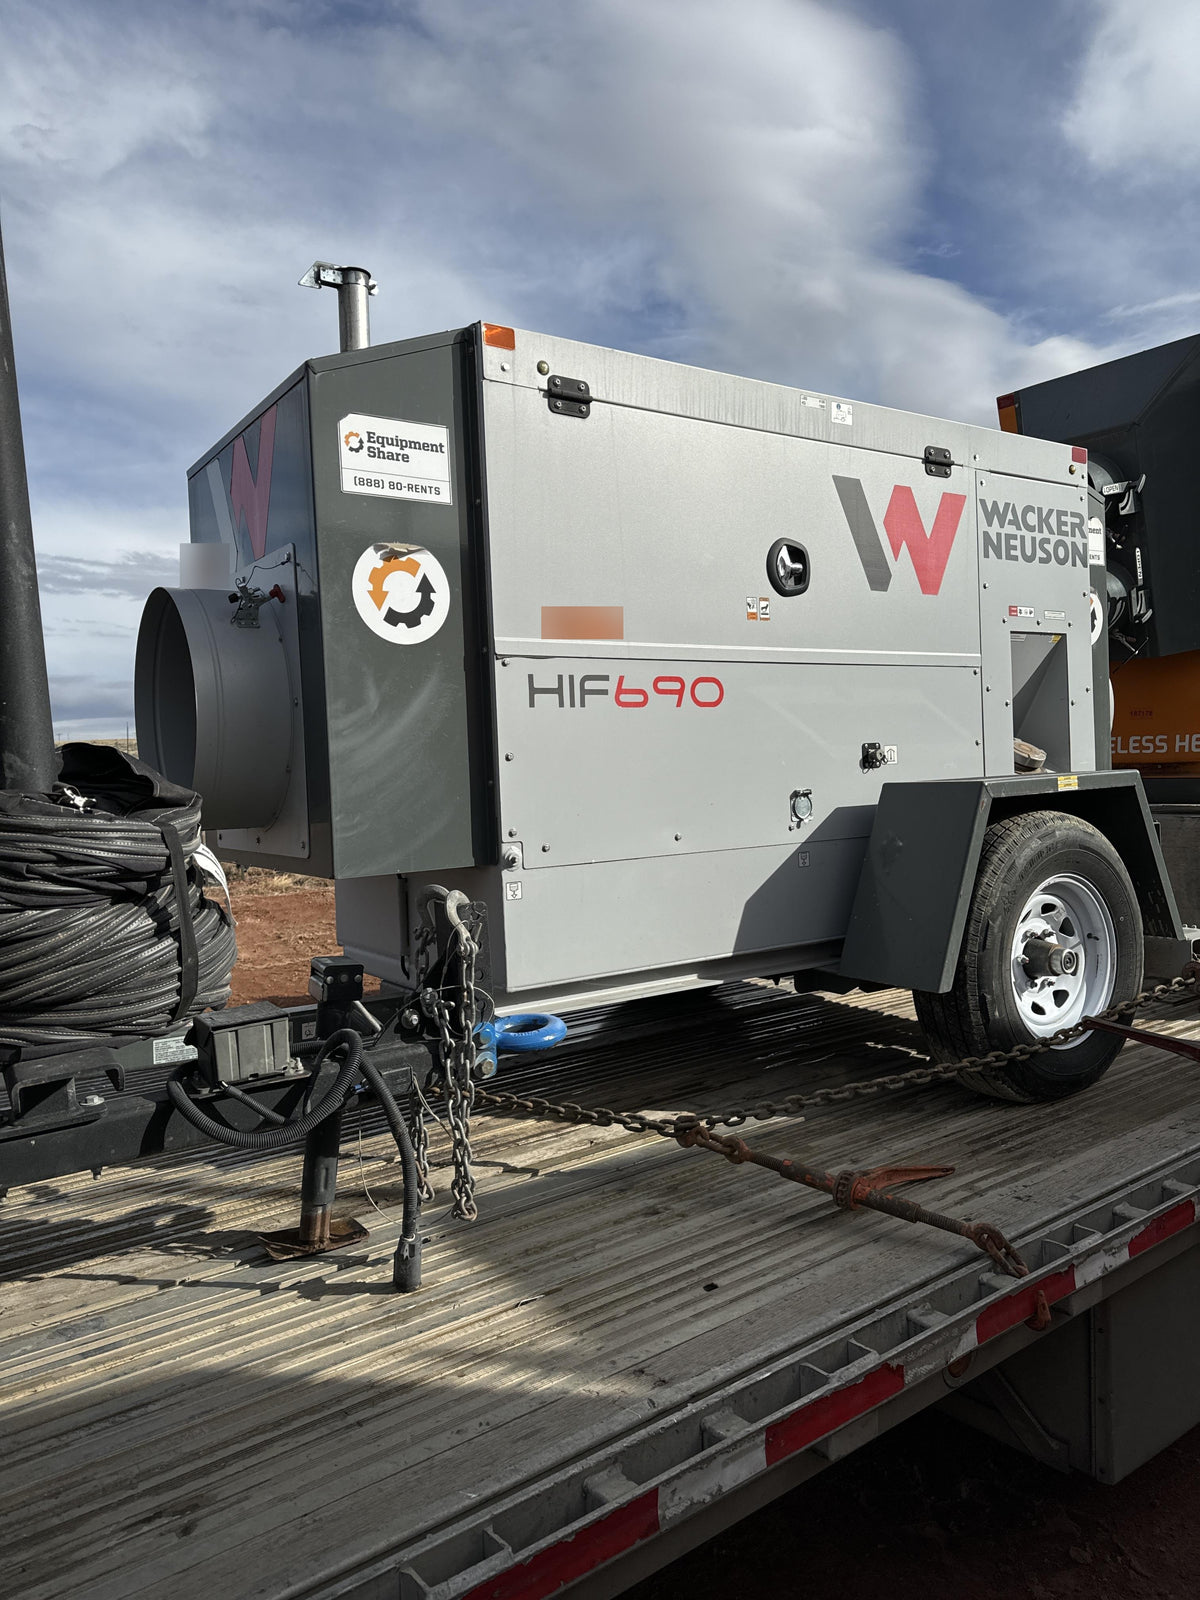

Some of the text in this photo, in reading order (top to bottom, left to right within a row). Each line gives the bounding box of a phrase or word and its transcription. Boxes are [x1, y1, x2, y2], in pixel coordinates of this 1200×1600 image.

[366, 431, 445, 454] Equipment
[367, 446, 410, 463] Share
[353, 475, 441, 496] (888) 80-RENTS
[979, 498, 1088, 539] WACKER
[983, 531, 1088, 568] NEUSON
[527, 673, 725, 708] HIF690
